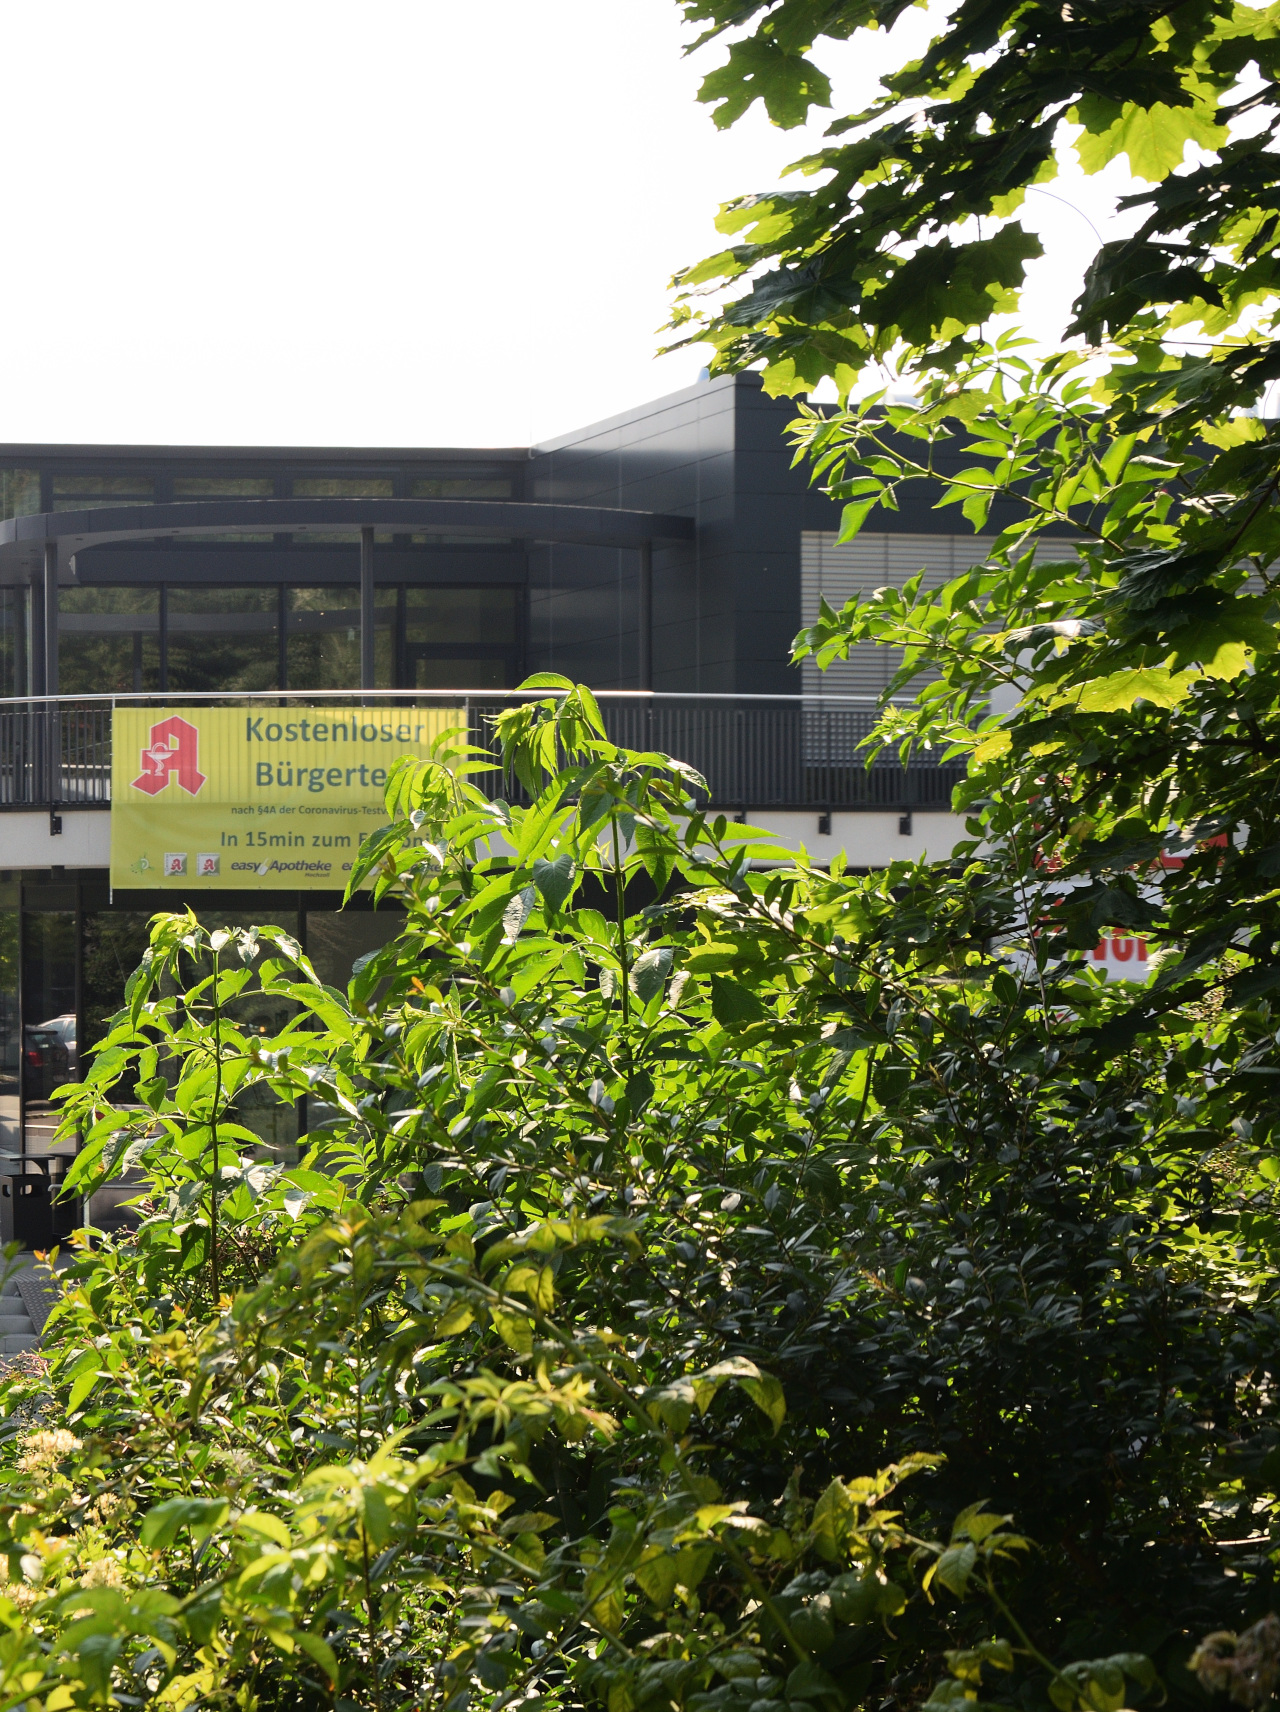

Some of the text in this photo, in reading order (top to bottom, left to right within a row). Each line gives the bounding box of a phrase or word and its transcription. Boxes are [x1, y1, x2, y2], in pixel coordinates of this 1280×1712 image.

[246, 716, 425, 742] Kostenloser
[256, 761, 412, 792] Bürgerte
[231, 806, 255, 815] nach
[257, 805, 277, 815] §4A
[279, 805, 295, 815] der
[221, 832, 238, 846] In
[246, 832, 305, 847] 15min
[312, 834, 351, 848] zum
[231, 862, 260, 873] easy
[270, 860, 332, 873] Apotheke
